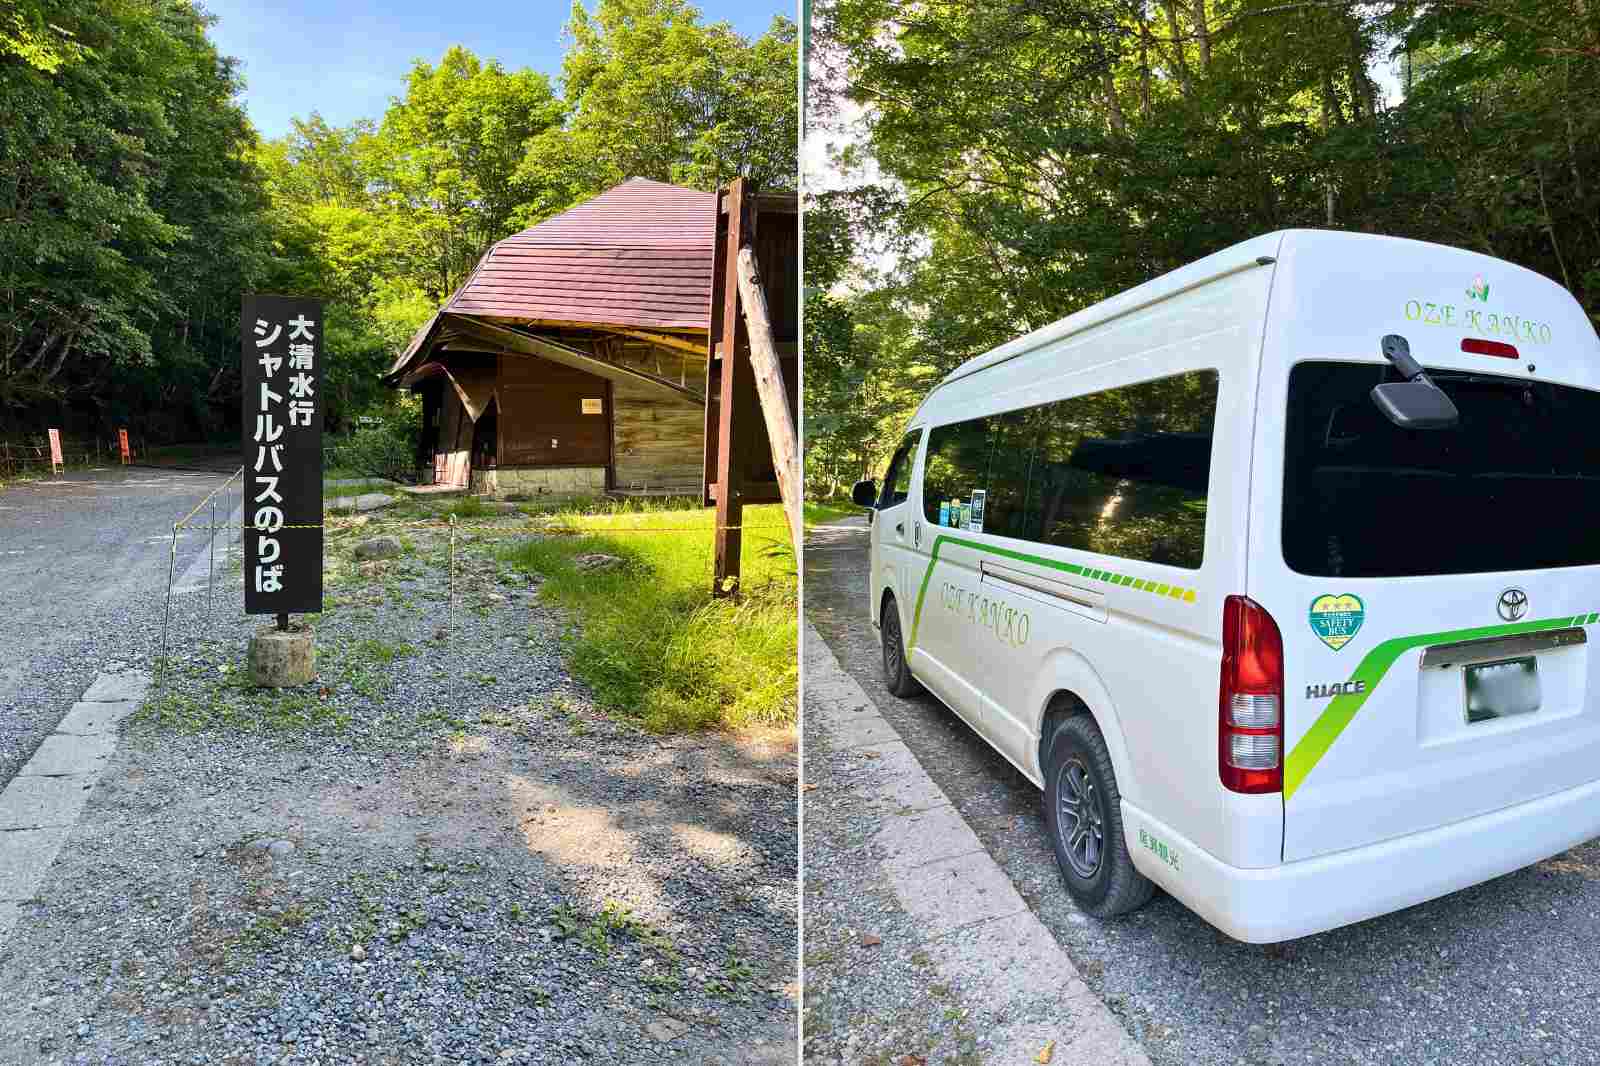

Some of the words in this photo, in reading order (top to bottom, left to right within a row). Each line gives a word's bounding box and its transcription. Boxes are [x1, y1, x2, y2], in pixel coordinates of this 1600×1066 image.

[1405, 299, 1456, 325] OZE
[1465, 308, 1553, 344] KANKO
[288, 313, 315, 427] 大清水行
[253, 318, 285, 593] シャトルバスのりば
[1305, 680, 1366, 700] HIACE
